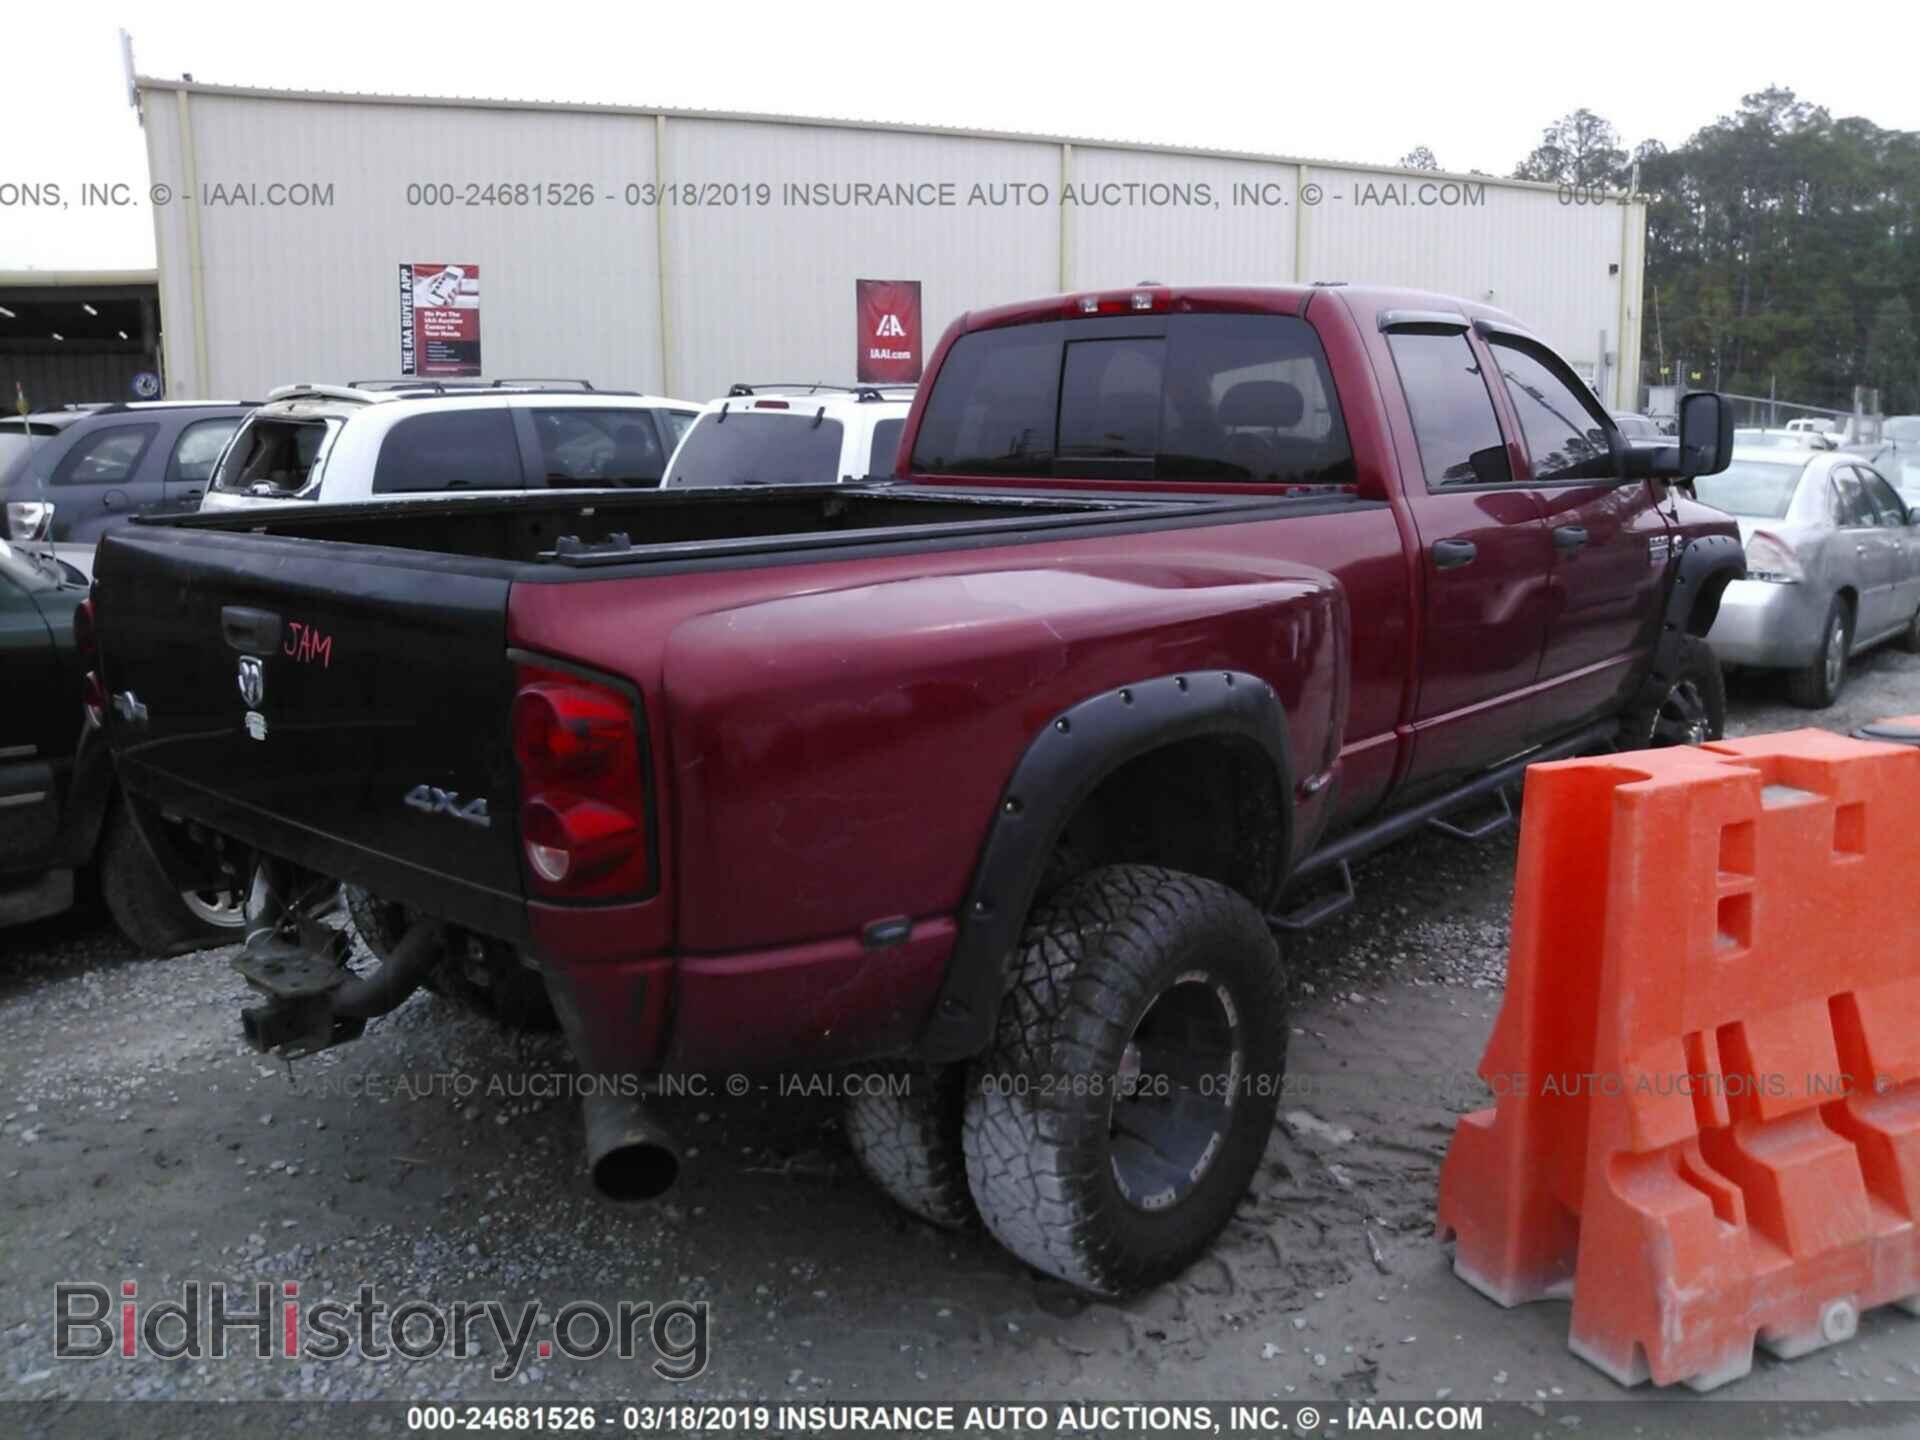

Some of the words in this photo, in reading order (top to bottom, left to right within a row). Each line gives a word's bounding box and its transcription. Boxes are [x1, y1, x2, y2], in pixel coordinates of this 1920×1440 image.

[400, 268, 412, 289] APP
[401, 292, 413, 327] BUYER
[402, 329, 413, 348] IAA
[402, 350, 414, 370] THE
[284, 622, 332, 669] JAM
